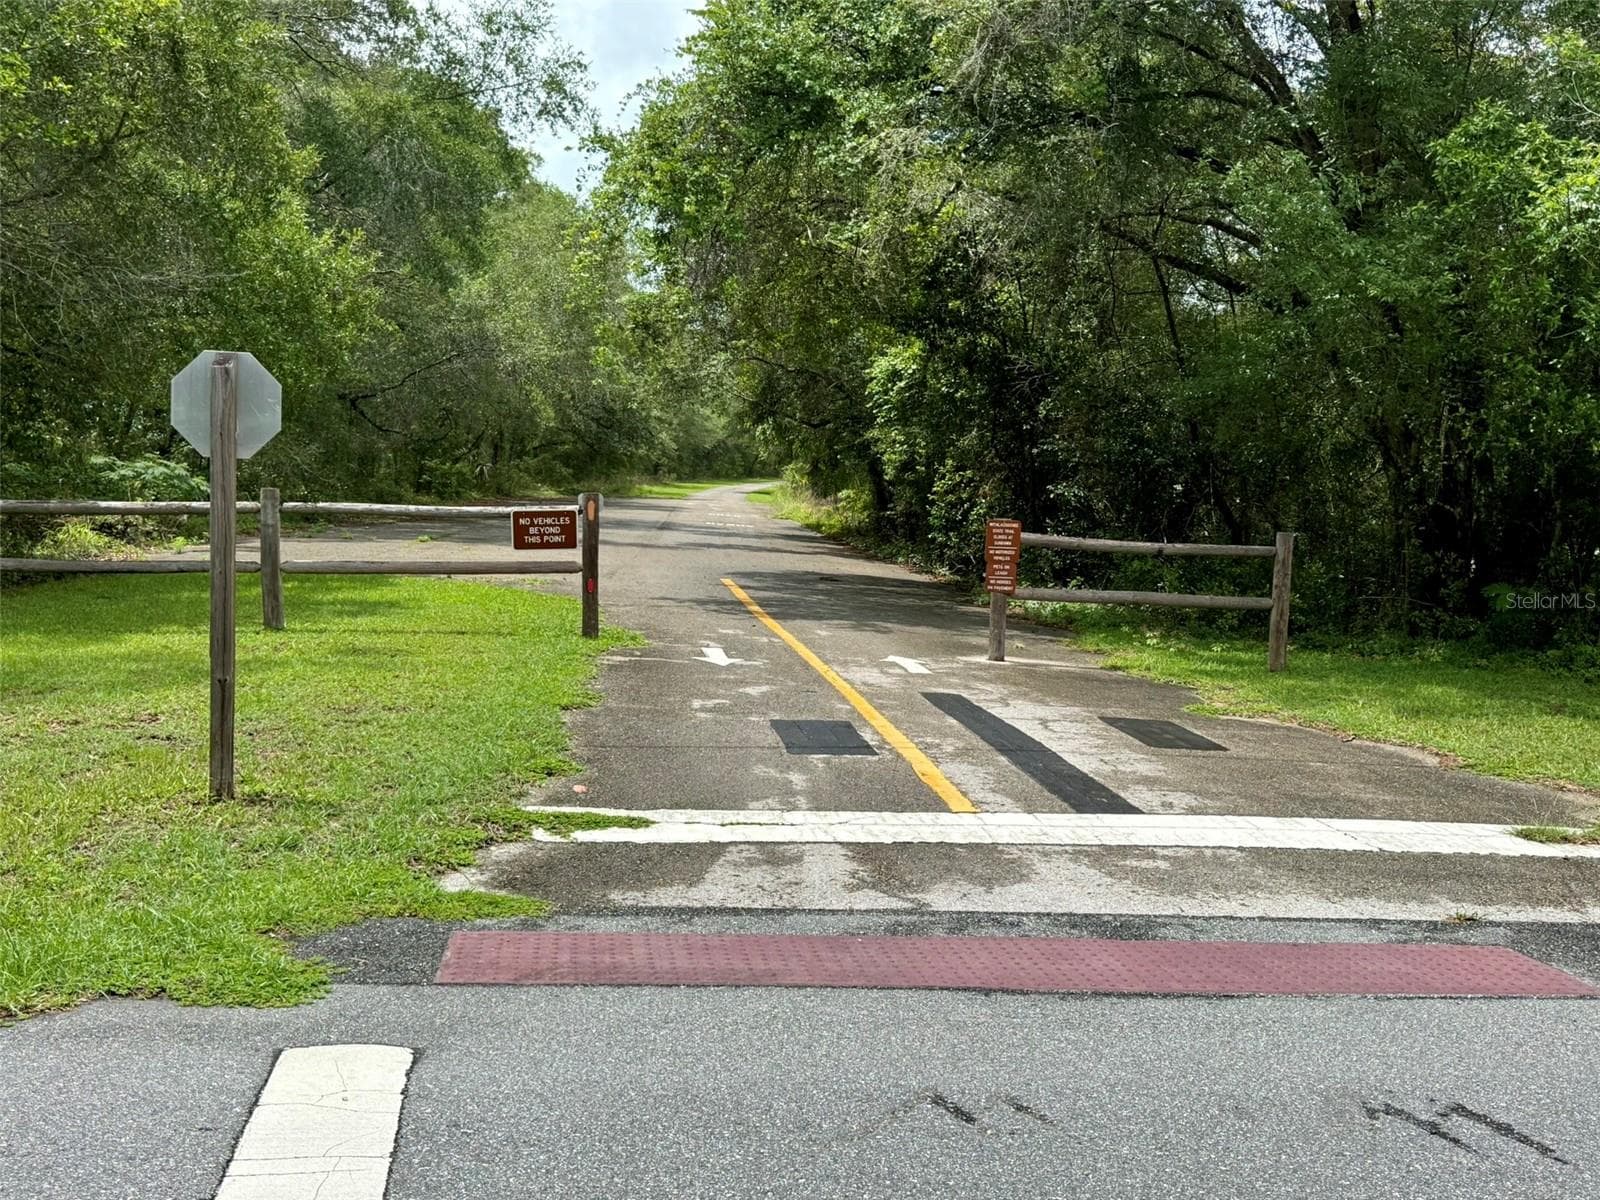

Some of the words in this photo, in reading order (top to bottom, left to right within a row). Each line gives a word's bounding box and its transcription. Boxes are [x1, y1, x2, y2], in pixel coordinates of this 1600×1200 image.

[532, 517, 570, 525] VEHICLES
[529, 526, 560, 534] BEYOND
[524, 536, 541, 544] THIS
[544, 535, 566, 543] POINT
